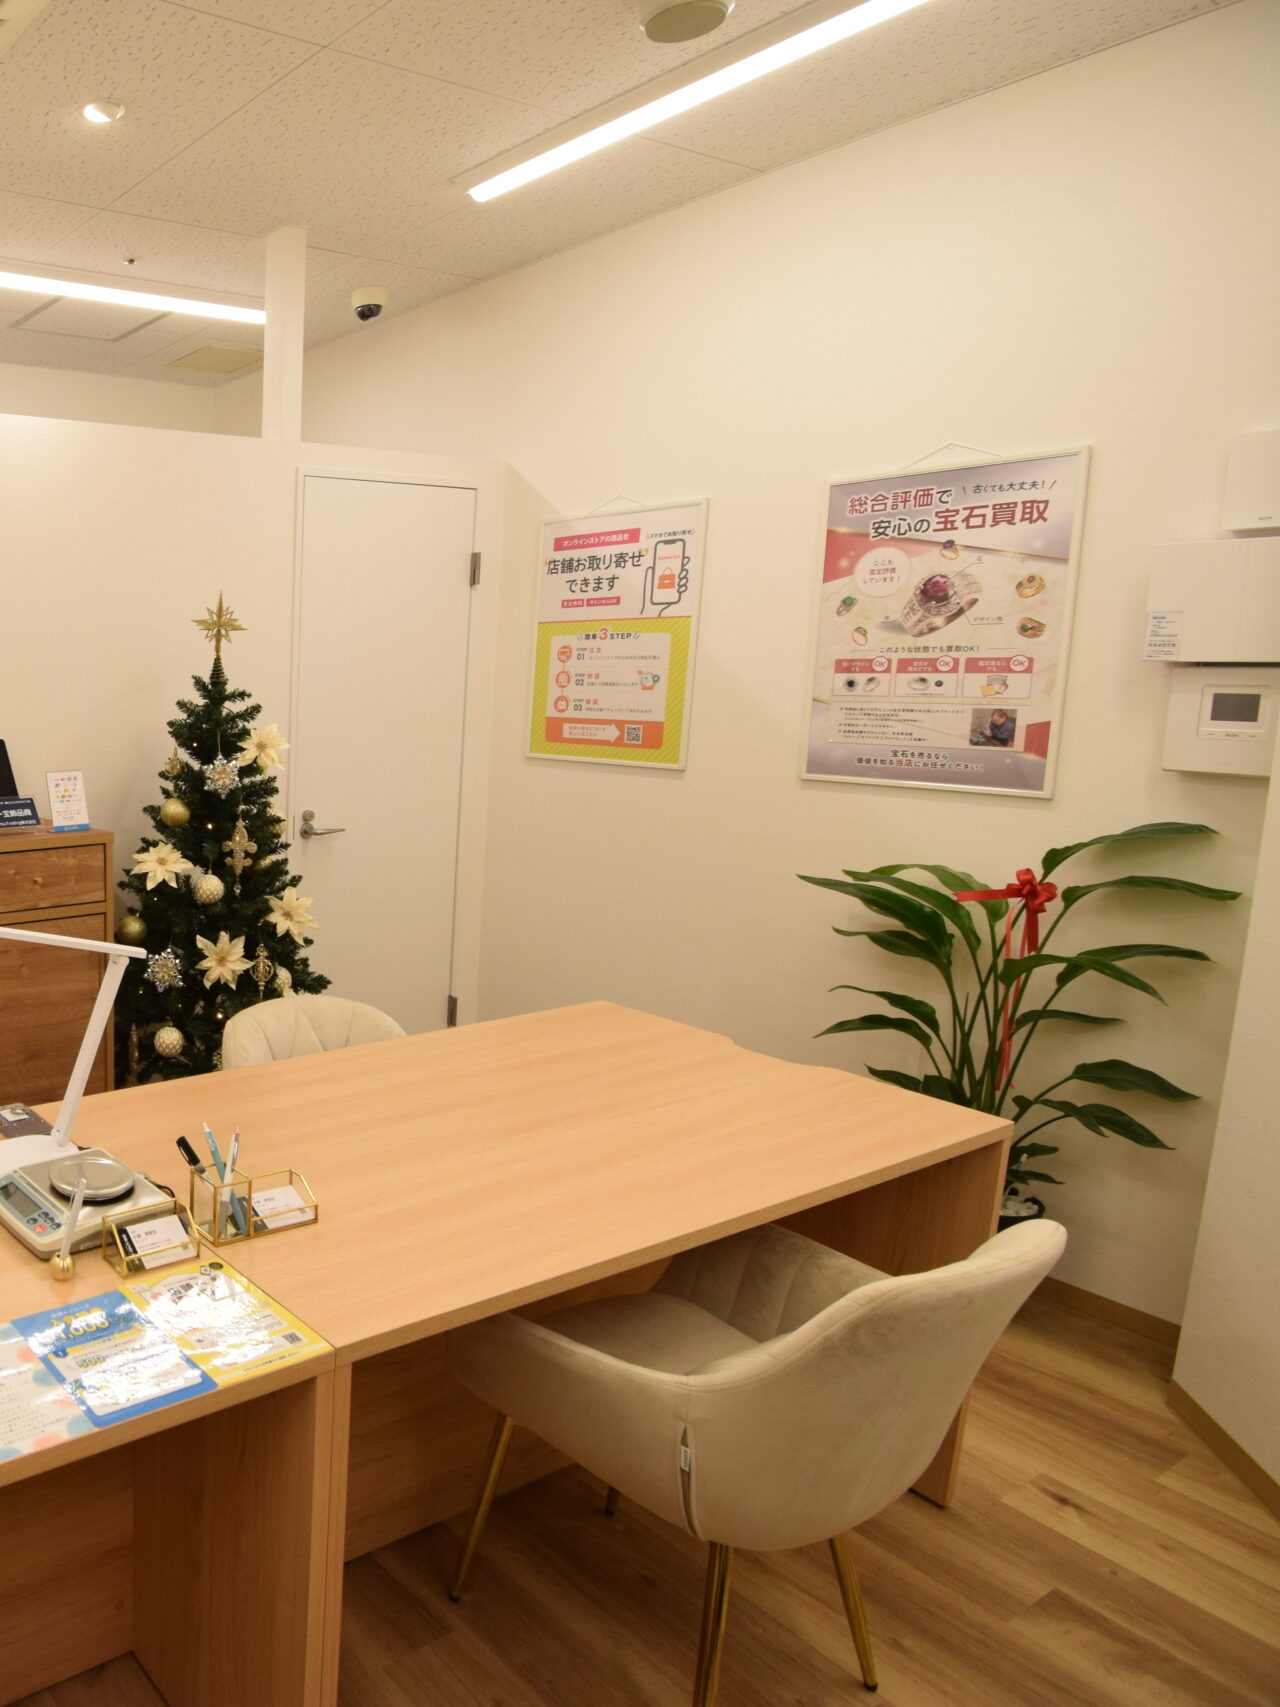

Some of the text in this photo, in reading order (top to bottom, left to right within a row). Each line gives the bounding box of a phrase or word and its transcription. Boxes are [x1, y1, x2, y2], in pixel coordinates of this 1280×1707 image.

[847, 488, 953, 516] 総合評価で
[871, 499, 1050, 539] 安心の宝石買取
[547, 550, 646, 575] 店舗お取り寄せ
[565, 574, 619, 593] できます
[1012, 659, 1027, 667] OK
